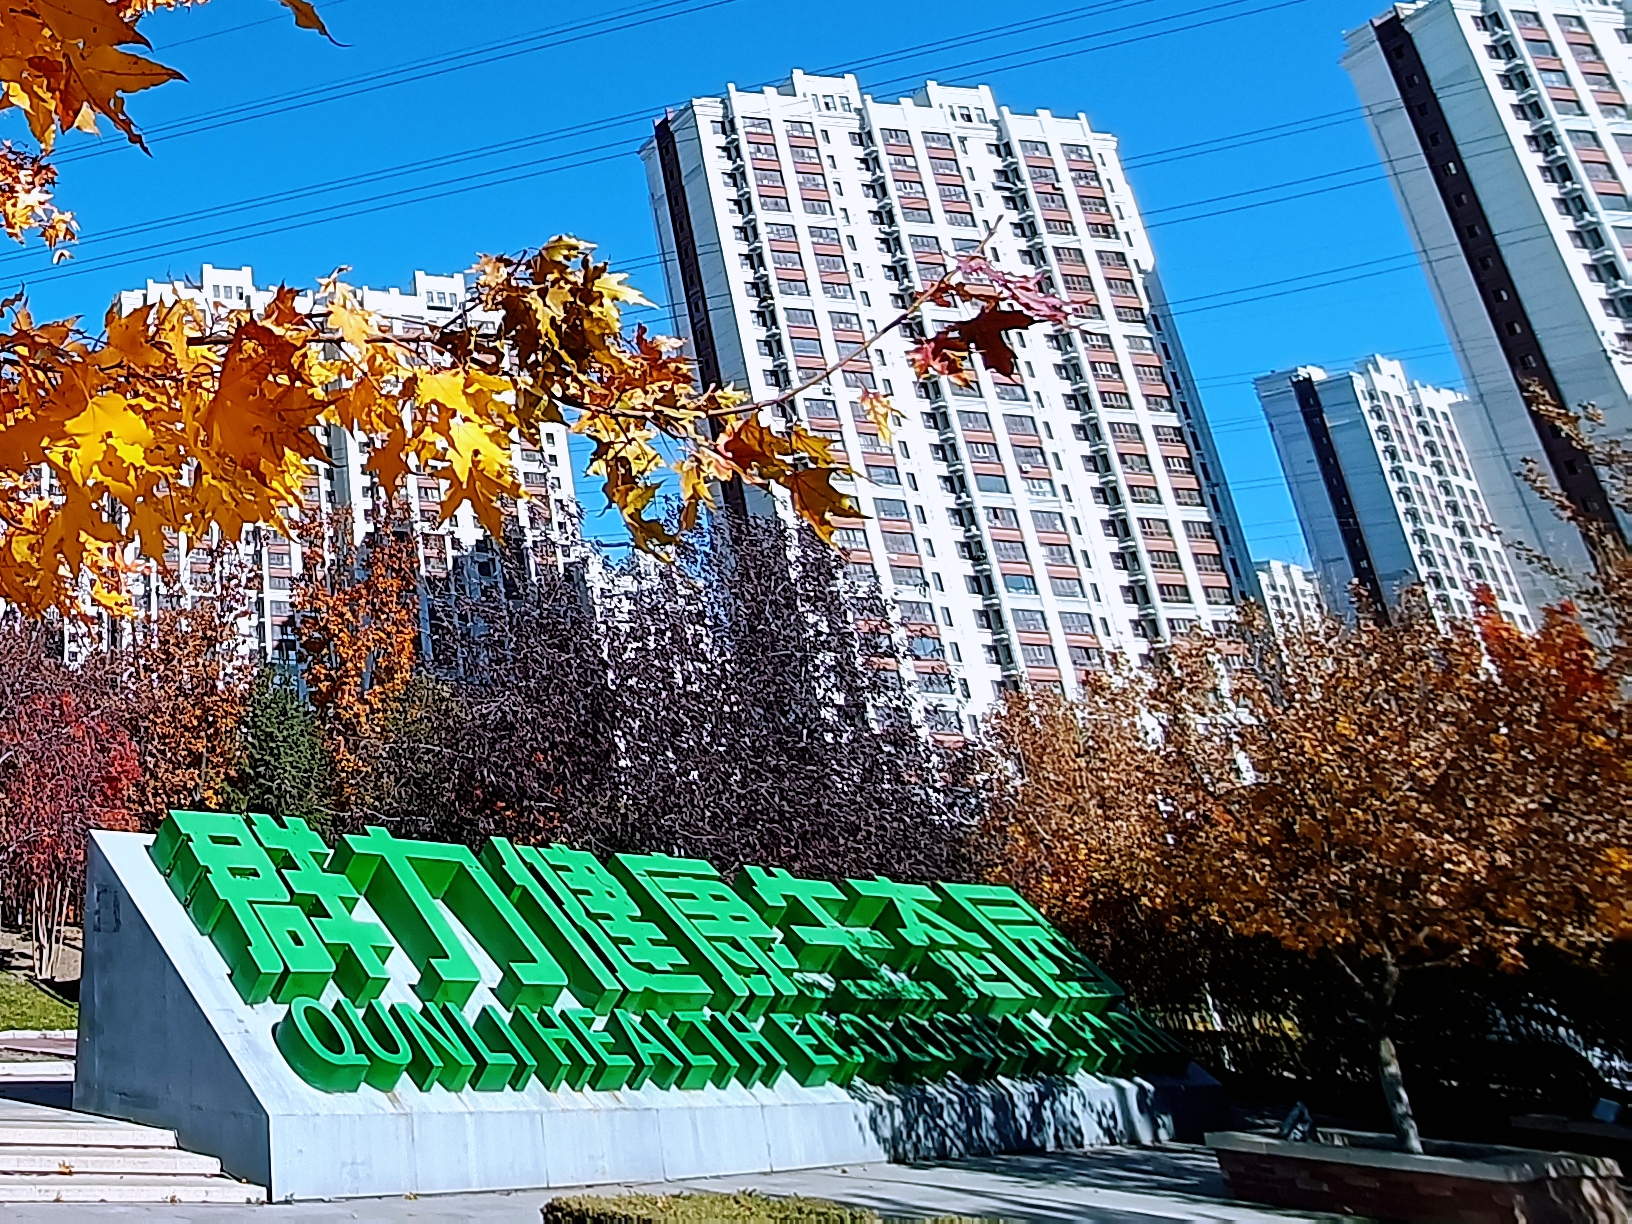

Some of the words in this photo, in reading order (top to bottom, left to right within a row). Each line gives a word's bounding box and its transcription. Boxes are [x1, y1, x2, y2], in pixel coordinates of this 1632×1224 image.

[154, 809, 1125, 1008] 群力健康生态园
[276, 996, 536, 1082] QUNLI
[515, 1004, 786, 1082] HEALTH
[768, 1012, 1086, 1080] ECOLOGICAL
